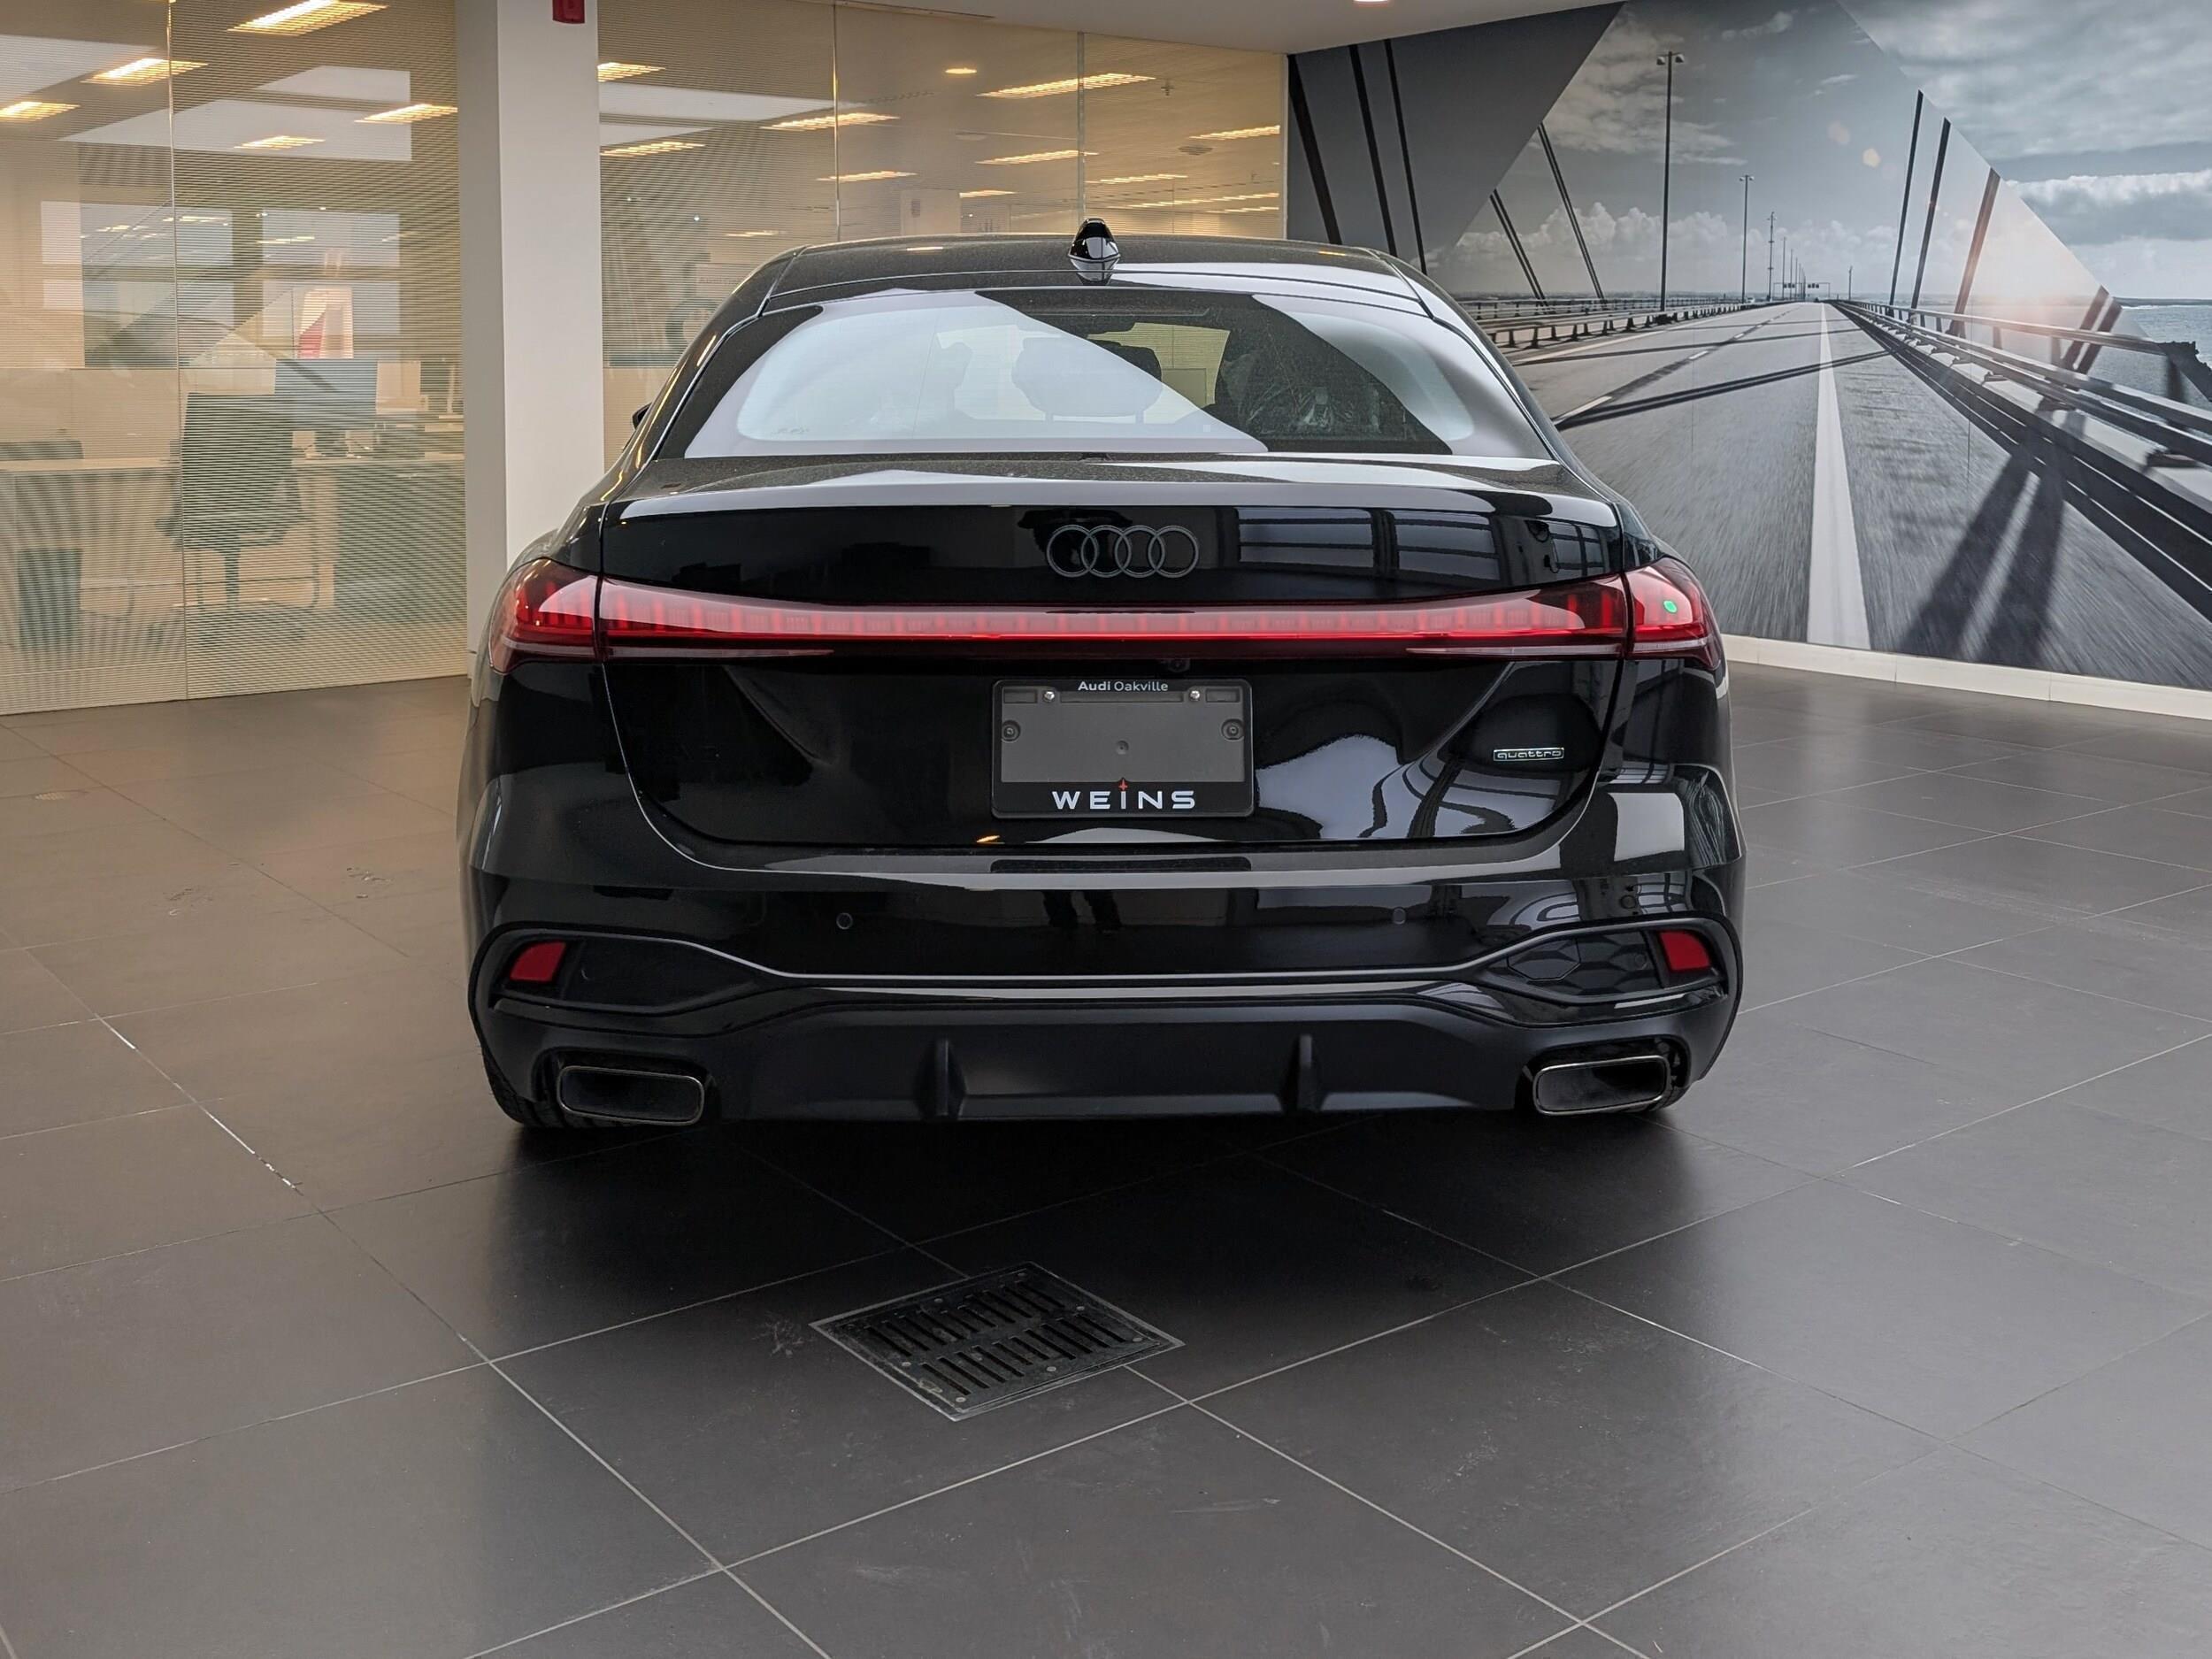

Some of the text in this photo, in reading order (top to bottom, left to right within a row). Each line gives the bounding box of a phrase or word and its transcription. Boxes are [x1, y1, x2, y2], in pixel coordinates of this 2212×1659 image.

[1078, 680, 1169, 692] Audi Oakville
[1497, 750, 1561, 760] quattro
